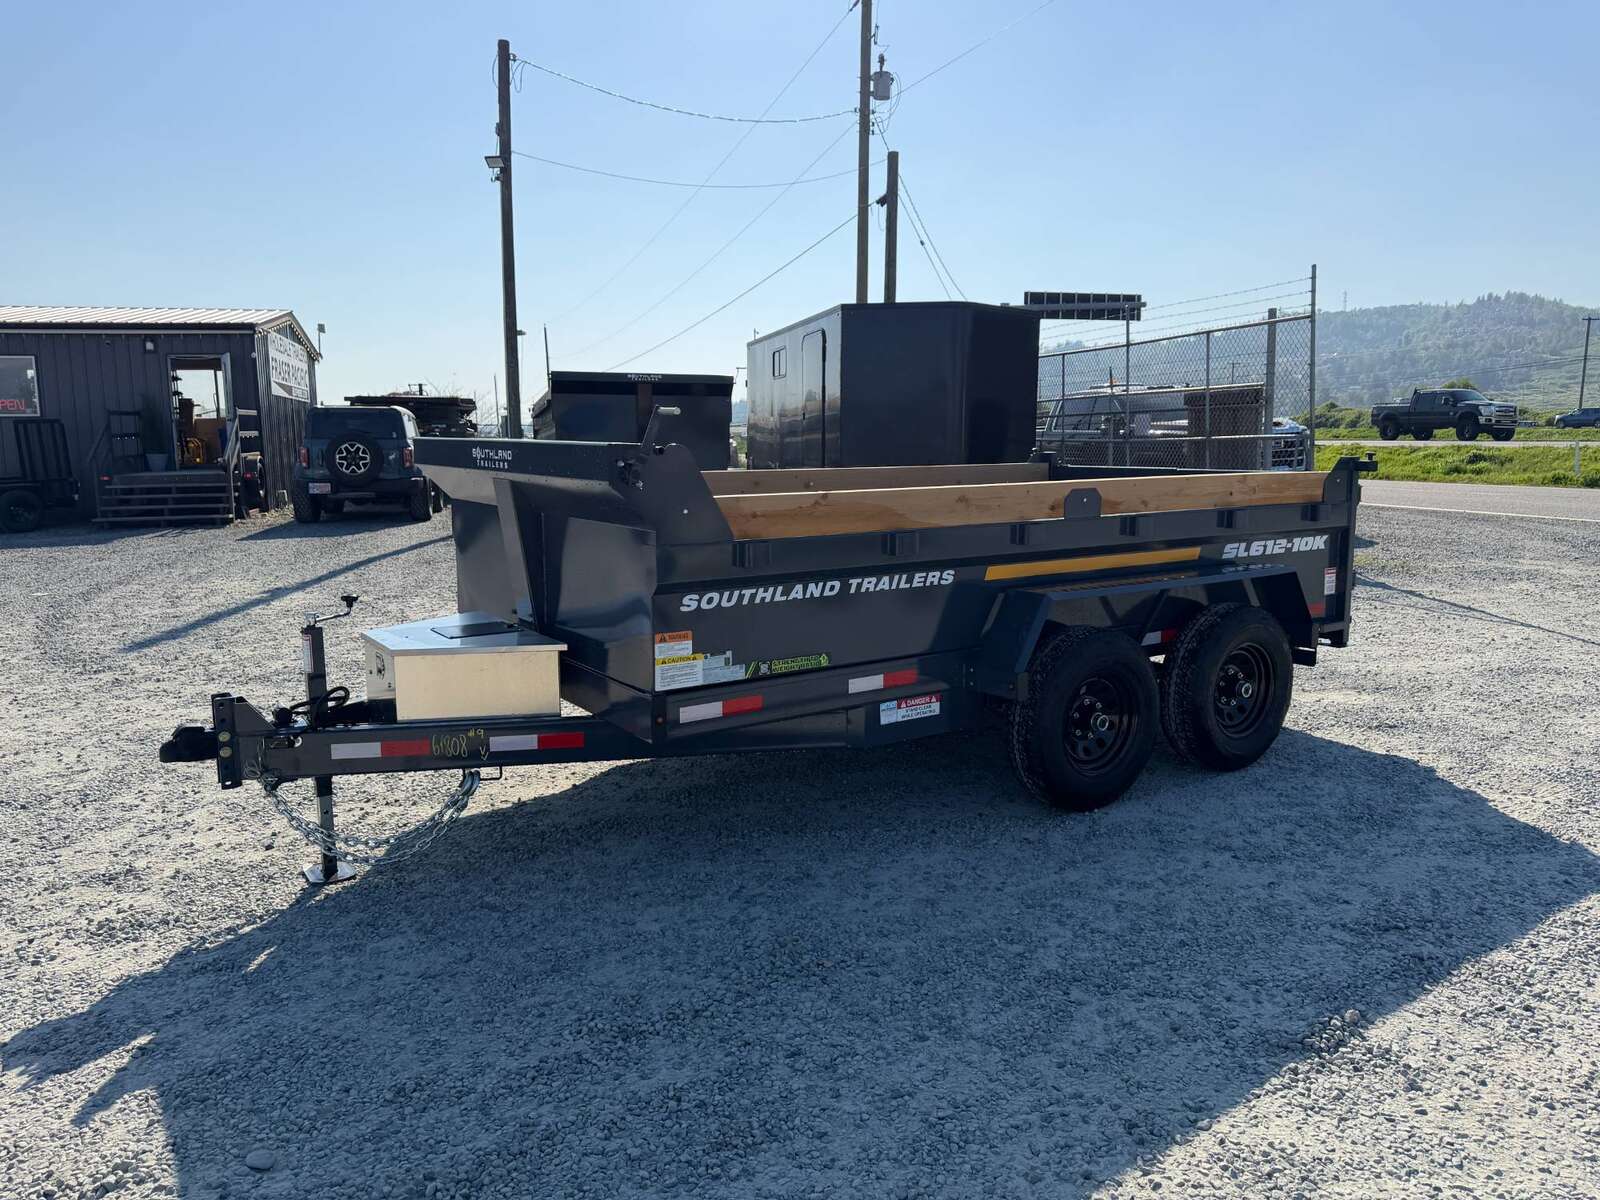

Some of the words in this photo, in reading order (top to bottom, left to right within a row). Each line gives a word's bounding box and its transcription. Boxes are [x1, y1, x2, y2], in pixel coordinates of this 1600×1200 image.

[271, 356, 291, 383] FRASER
[0, 399, 25, 410] PEN
[472, 446, 512, 460] SOUTHLAND
[477, 460, 508, 469] TRAILERS
[1222, 535, 1329, 559] SL612-10K
[680, 580, 840, 612] SOUTHLAND
[848, 569, 955, 594] TRAILERS
[667, 655, 691, 664] CAUTION
[907, 697, 930, 706] DANGER
